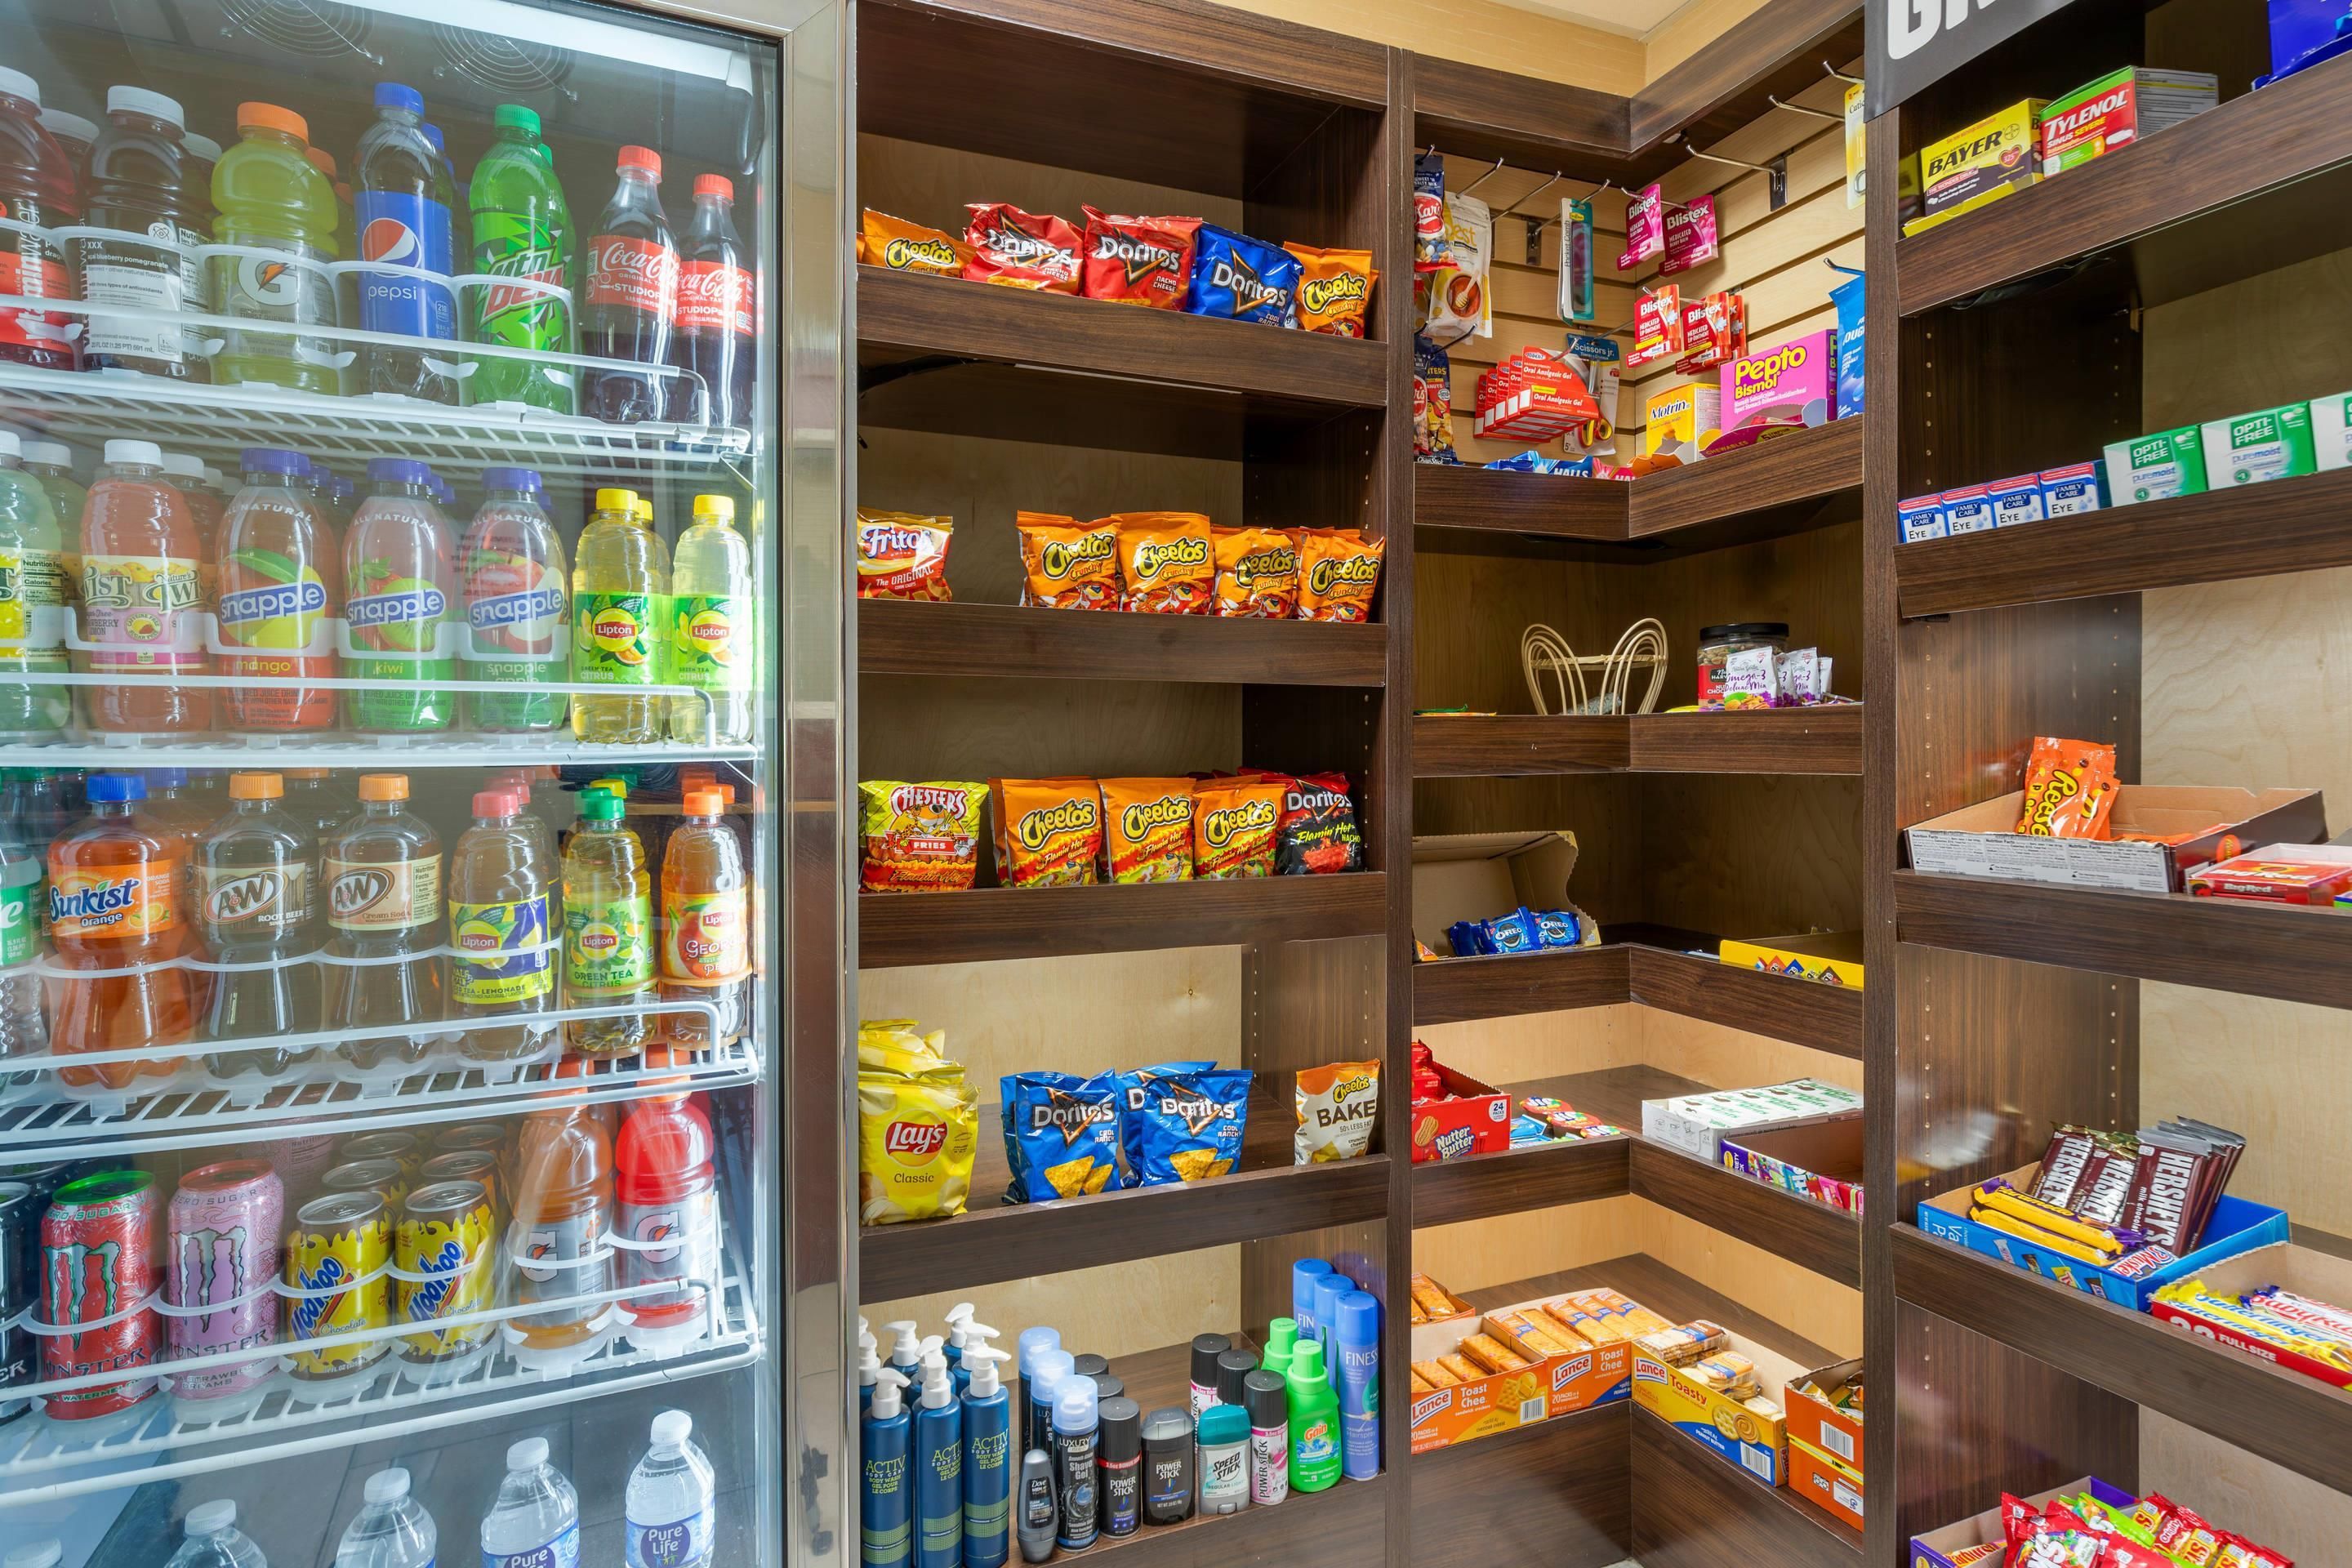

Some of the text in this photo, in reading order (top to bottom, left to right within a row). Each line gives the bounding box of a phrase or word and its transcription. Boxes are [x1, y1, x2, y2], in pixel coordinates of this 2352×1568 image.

[2045, 90, 2128, 141] TYLENOL
[2047, 117, 2106, 148] SINUS SEVERE
[1928, 131, 2002, 177] BAYER
[1628, 194, 1657, 219] Blistex
[1667, 204, 1709, 230] Blistex
[1669, 229, 1691, 243] MEDICATED
[87, 241, 103, 250] XXX
[885, 238, 956, 269] Cheetos
[1098, 234, 1181, 272] Doritos
[97, 254, 169, 270] blueberry pomegranate
[1153, 281, 1177, 293] CHEESE
[1156, 275, 1178, 286] NACHO
[1212, 262, 1287, 307] Doritos
[368, 285, 417, 301] pepsi
[1303, 273, 1368, 314] Cheetos
[1325, 301, 1357, 317] Crunchy
[1640, 295, 1673, 317] Blistex
[1688, 301, 1722, 323] Blistex
[1574, 343, 1606, 354] Scissors
[1537, 369, 1561, 378] Analgesic
[1734, 345, 1807, 385] Pepto
[1735, 376, 1779, 400] Bismol
[1548, 396, 1572, 405] Analgesic
[1573, 399, 1584, 407] Gel
[1650, 400, 1686, 421] Motrin
[2234, 417, 2272, 438] OPTI-
[2235, 426, 2274, 446] FREE
[2133, 439, 2167, 458] OPTI-
[2232, 446, 2281, 464] puremoist
[2135, 449, 2169, 467] FREE
[1554, 468, 1588, 477] HALLS
[2132, 466, 2176, 483] puremoist
[2056, 483, 2082, 494] FAMILY
[2059, 488, 2080, 498] CARE
[2003, 493, 2028, 504] FAMILY
[2006, 500, 2026, 509] CARE
[241, 504, 314, 523] NATURAL
[1911, 510, 1933, 521] FAMILY
[1956, 503, 1979, 514] FAMILY
[1958, 508, 1976, 518] CARE
[2051, 503, 2074, 514] EYE
[353, 514, 437, 531] ALL NATURAL
[493, 514, 554, 532] NATURAL
[1913, 517, 1932, 527] CARE
[1953, 522, 1971, 531] EYE
[2000, 513, 2020, 523] EYE
[1909, 531, 1927, 539] EYE
[1042, 532, 1114, 579] Cheetos
[1134, 539, 1208, 579] Cheetos
[875, 567, 934, 587] The ORIGINAL
[1069, 562, 1103, 581] Crunchy
[1160, 567, 1193, 581] Crunchy
[1236, 548, 1295, 589] Cheetos
[1310, 555, 1380, 594] Cheetos
[1252, 577, 1283, 592] Crunchy
[1327, 586, 1363, 599] Crunchy
[220, 585, 321, 623] snapple
[347, 593, 442, 628] snapple
[471, 593, 563, 628] snapple
[598, 624, 632, 636] Lipton
[695, 626, 727, 637] Lipton
[236, 660, 292, 677] mango
[375, 662, 403, 674] kiwi
[487, 662, 546, 675] snapple
[581, 672, 614, 680] CITRUS
[892, 786, 968, 817] CHESTER'S
[1287, 791, 1352, 812] Doritos
[1019, 800, 1096, 850] Cheetos
[1123, 795, 1192, 841] Cheetos
[1205, 801, 1276, 848] Cheetos
[1169, 831, 1183, 843] Hot
[1297, 823, 1353, 844] Flamin' Hot
[1341, 835, 1361, 843] NACHO
[914, 841, 946, 850] FRIES
[1071, 839, 1085, 850] Hot
[415, 866, 436, 874] Nutrition
[50, 878, 141, 924] Sunkist
[216, 872, 269, 920] A&W
[334, 872, 373, 915] A&W
[81, 913, 123, 928] Orange
[258, 910, 304, 922] ROOT BEER
[1540, 920, 1569, 929] OREO
[463, 936, 495, 947] Lipton
[1495, 927, 1522, 941] OREO
[584, 938, 613, 948] Lipton
[574, 969, 634, 982] GREEN TEA
[482, 985, 526, 995] LEMONADE
[1334, 1076, 1370, 1103] Cheetos
[1160, 1098, 1236, 1120] Doritos
[1493, 1102, 1503, 1111] 24
[1033, 1102, 1116, 1129] Doritos
[1223, 1125, 1238, 1133] COOL
[1350, 1122, 1363, 1130] LESS
[889, 1122, 945, 1154] Lay's
[1435, 1126, 1471, 1149] Nutter
[1440, 1135, 1475, 1160] Butter
[893, 1172, 934, 1183] Classic
[206, 1188, 258, 1206] SUGAR
[2143, 1152, 2194, 1246] HERSHEY'S
[76, 1203, 131, 1220] SUGAR
[320, 1317, 367, 1335] Chocolate
[1599, 1348, 1624, 1361] Toast
[2219, 1334, 2277, 1361] FULL SIZE
[1555, 1358, 1590, 1384] Lance
[1600, 1360, 1623, 1372] Chee
[1635, 1358, 1666, 1379] Lance
[1460, 1383, 1487, 1396] Toast
[1669, 1374, 1708, 1405] Toasty
[1412, 1393, 1450, 1419] Lance
[1461, 1395, 1486, 1407] Chee
[1552, 1394, 1561, 1404] 20
[972, 1428, 1009, 1450] ACTIV
[1304, 1423, 1327, 1442] Gain
[1059, 1437, 1090, 1448] LUXURY
[866, 1454, 906, 1474] ACTIV
[1069, 1460, 1093, 1472] Shave
[1156, 1461, 1182, 1474] POWER
[1213, 1451, 1241, 1472] SPEED
[1259, 1440, 1269, 1499] POWER STICK
[1075, 1469, 1089, 1480] Gel
[1160, 1471, 1179, 1480] STICK
[1216, 1460, 1241, 1481] STICK
[1031, 1479, 1046, 1488] Dove
[1110, 1477, 1136, 1490] POWER
[1113, 1486, 1134, 1497] STICK
[648, 1526, 683, 1542] Pure
[653, 1539, 679, 1557] Life
[510, 1549, 548, 1567] Pure
